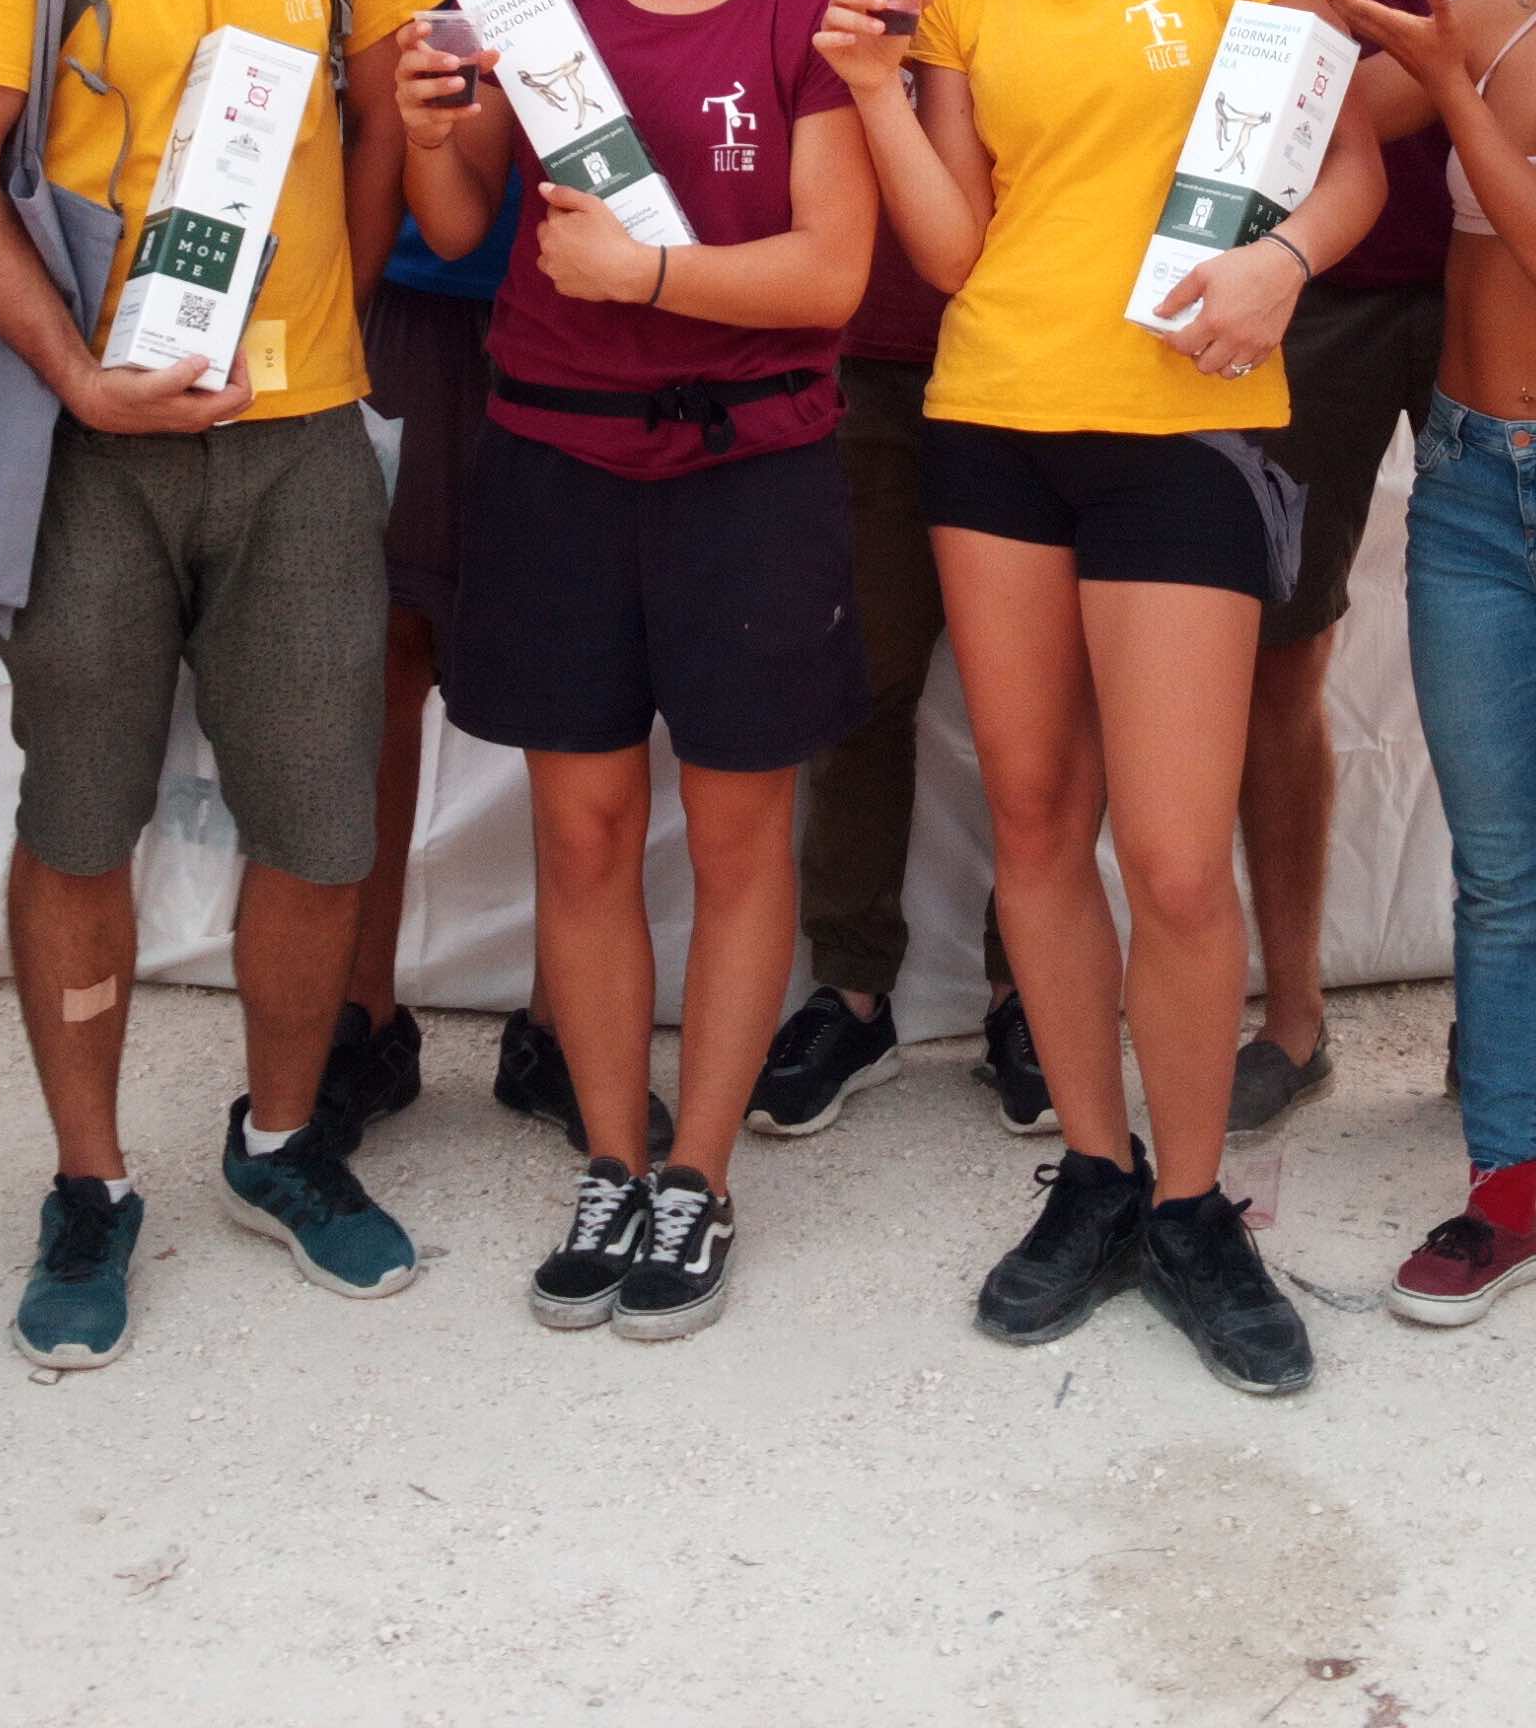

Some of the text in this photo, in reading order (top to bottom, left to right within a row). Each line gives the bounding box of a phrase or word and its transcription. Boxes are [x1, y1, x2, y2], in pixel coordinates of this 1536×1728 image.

[1228, 26, 1288, 48] GIORNATA
[1224, 40, 1294, 64] NAZIONALE
[714, 149, 740, 172] FLIC
[186, 221, 231, 244] PIE
[177, 239, 226, 264] MON
[175, 258, 202, 277] TE
